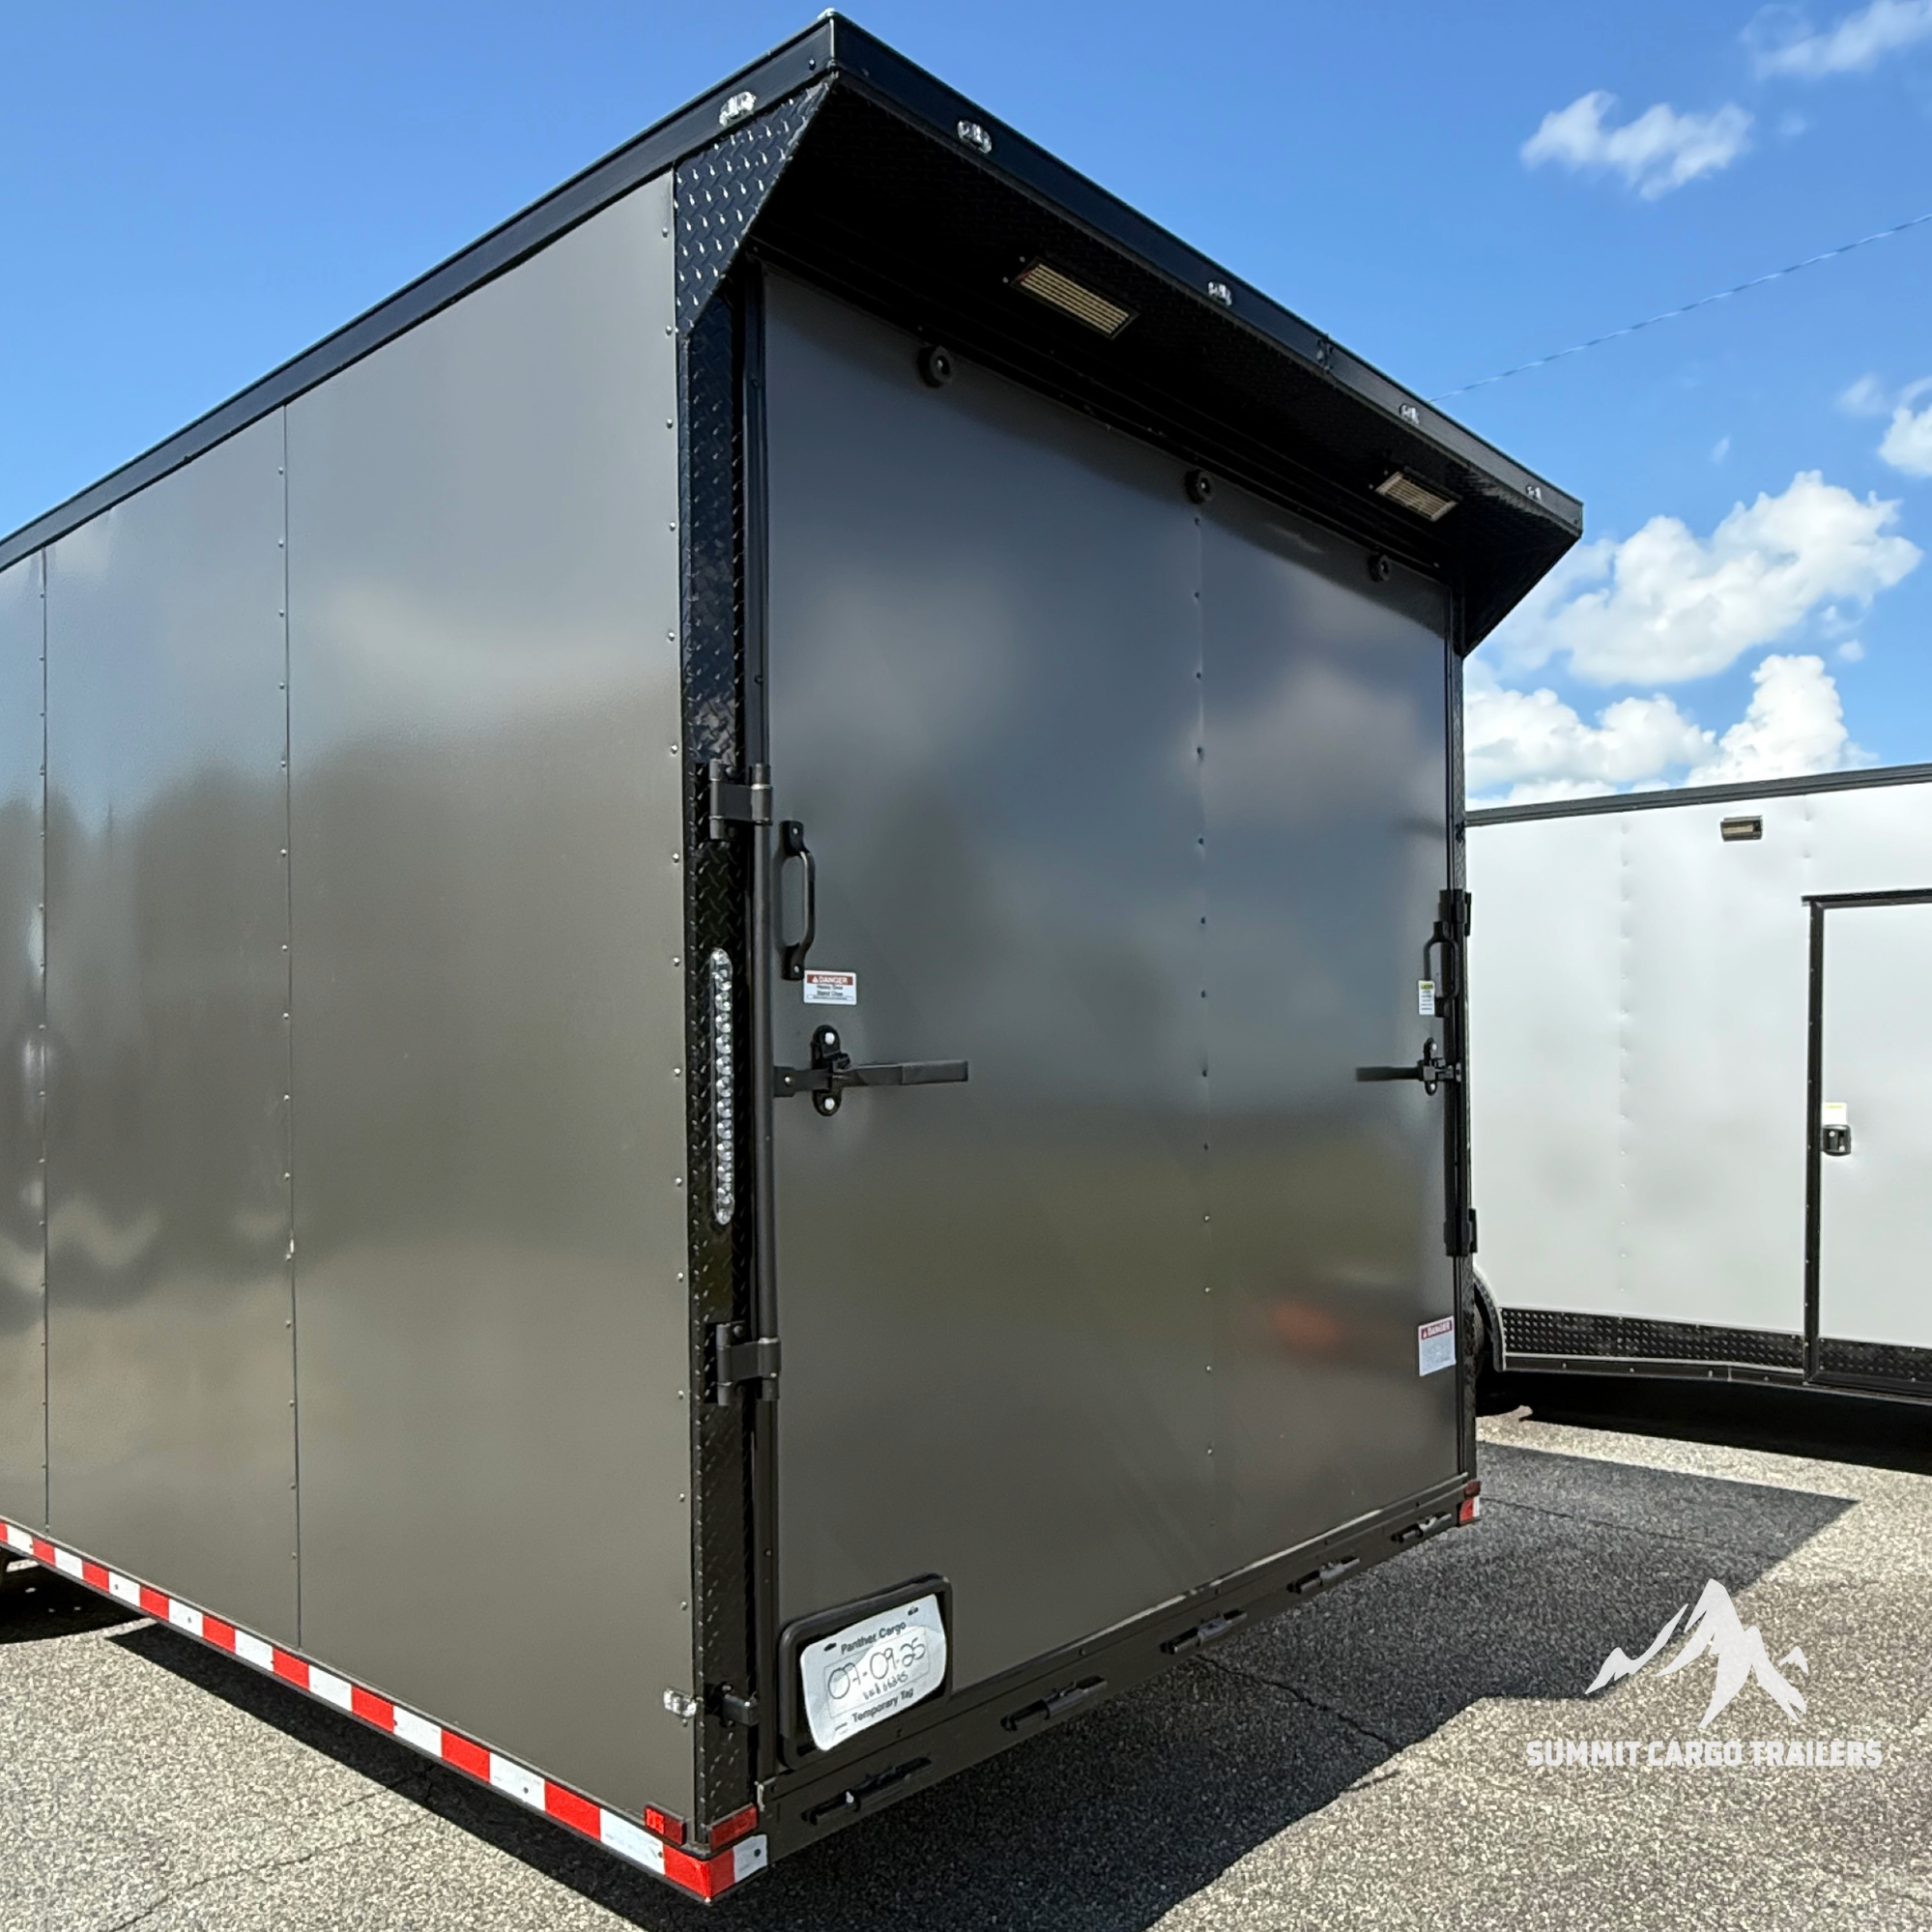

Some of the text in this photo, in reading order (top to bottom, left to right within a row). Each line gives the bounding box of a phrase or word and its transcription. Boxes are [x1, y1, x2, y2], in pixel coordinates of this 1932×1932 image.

[819, 975, 848, 984] DANGER
[841, 1622, 907, 1655] Panther Cargo
[851, 1695, 899, 1722] Temporary
[900, 1687, 914, 1700] Tag
